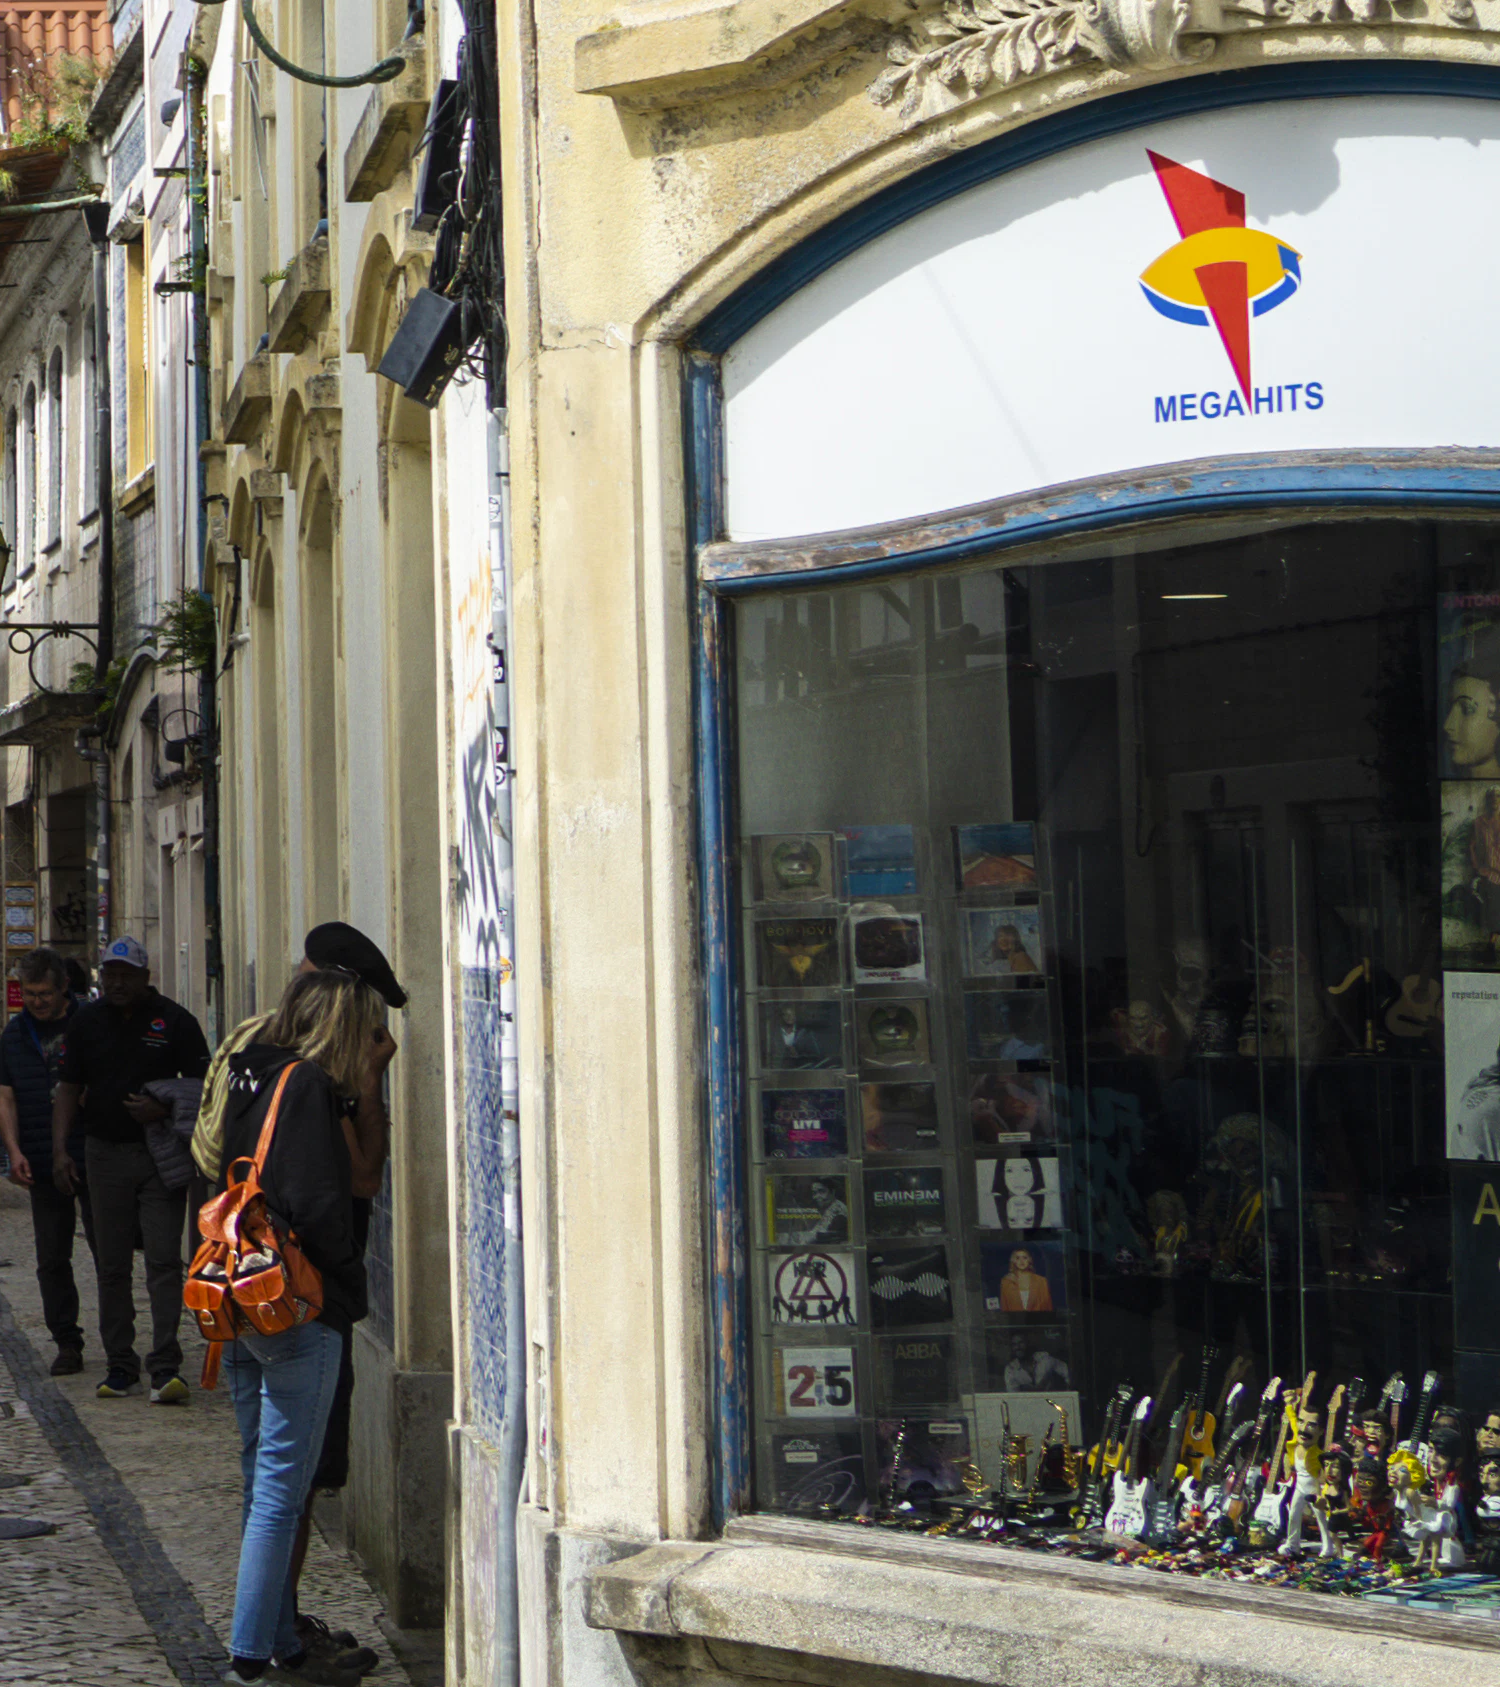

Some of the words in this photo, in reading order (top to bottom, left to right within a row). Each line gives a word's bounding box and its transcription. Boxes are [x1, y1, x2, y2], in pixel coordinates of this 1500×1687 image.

[1154, 389, 1244, 423] MEGA
[1253, 380, 1325, 416] HITS
[1451, 991, 1499, 1000] reputation
[894, 1343, 943, 1360] ABBA
[786, 1365, 853, 1407] 25
